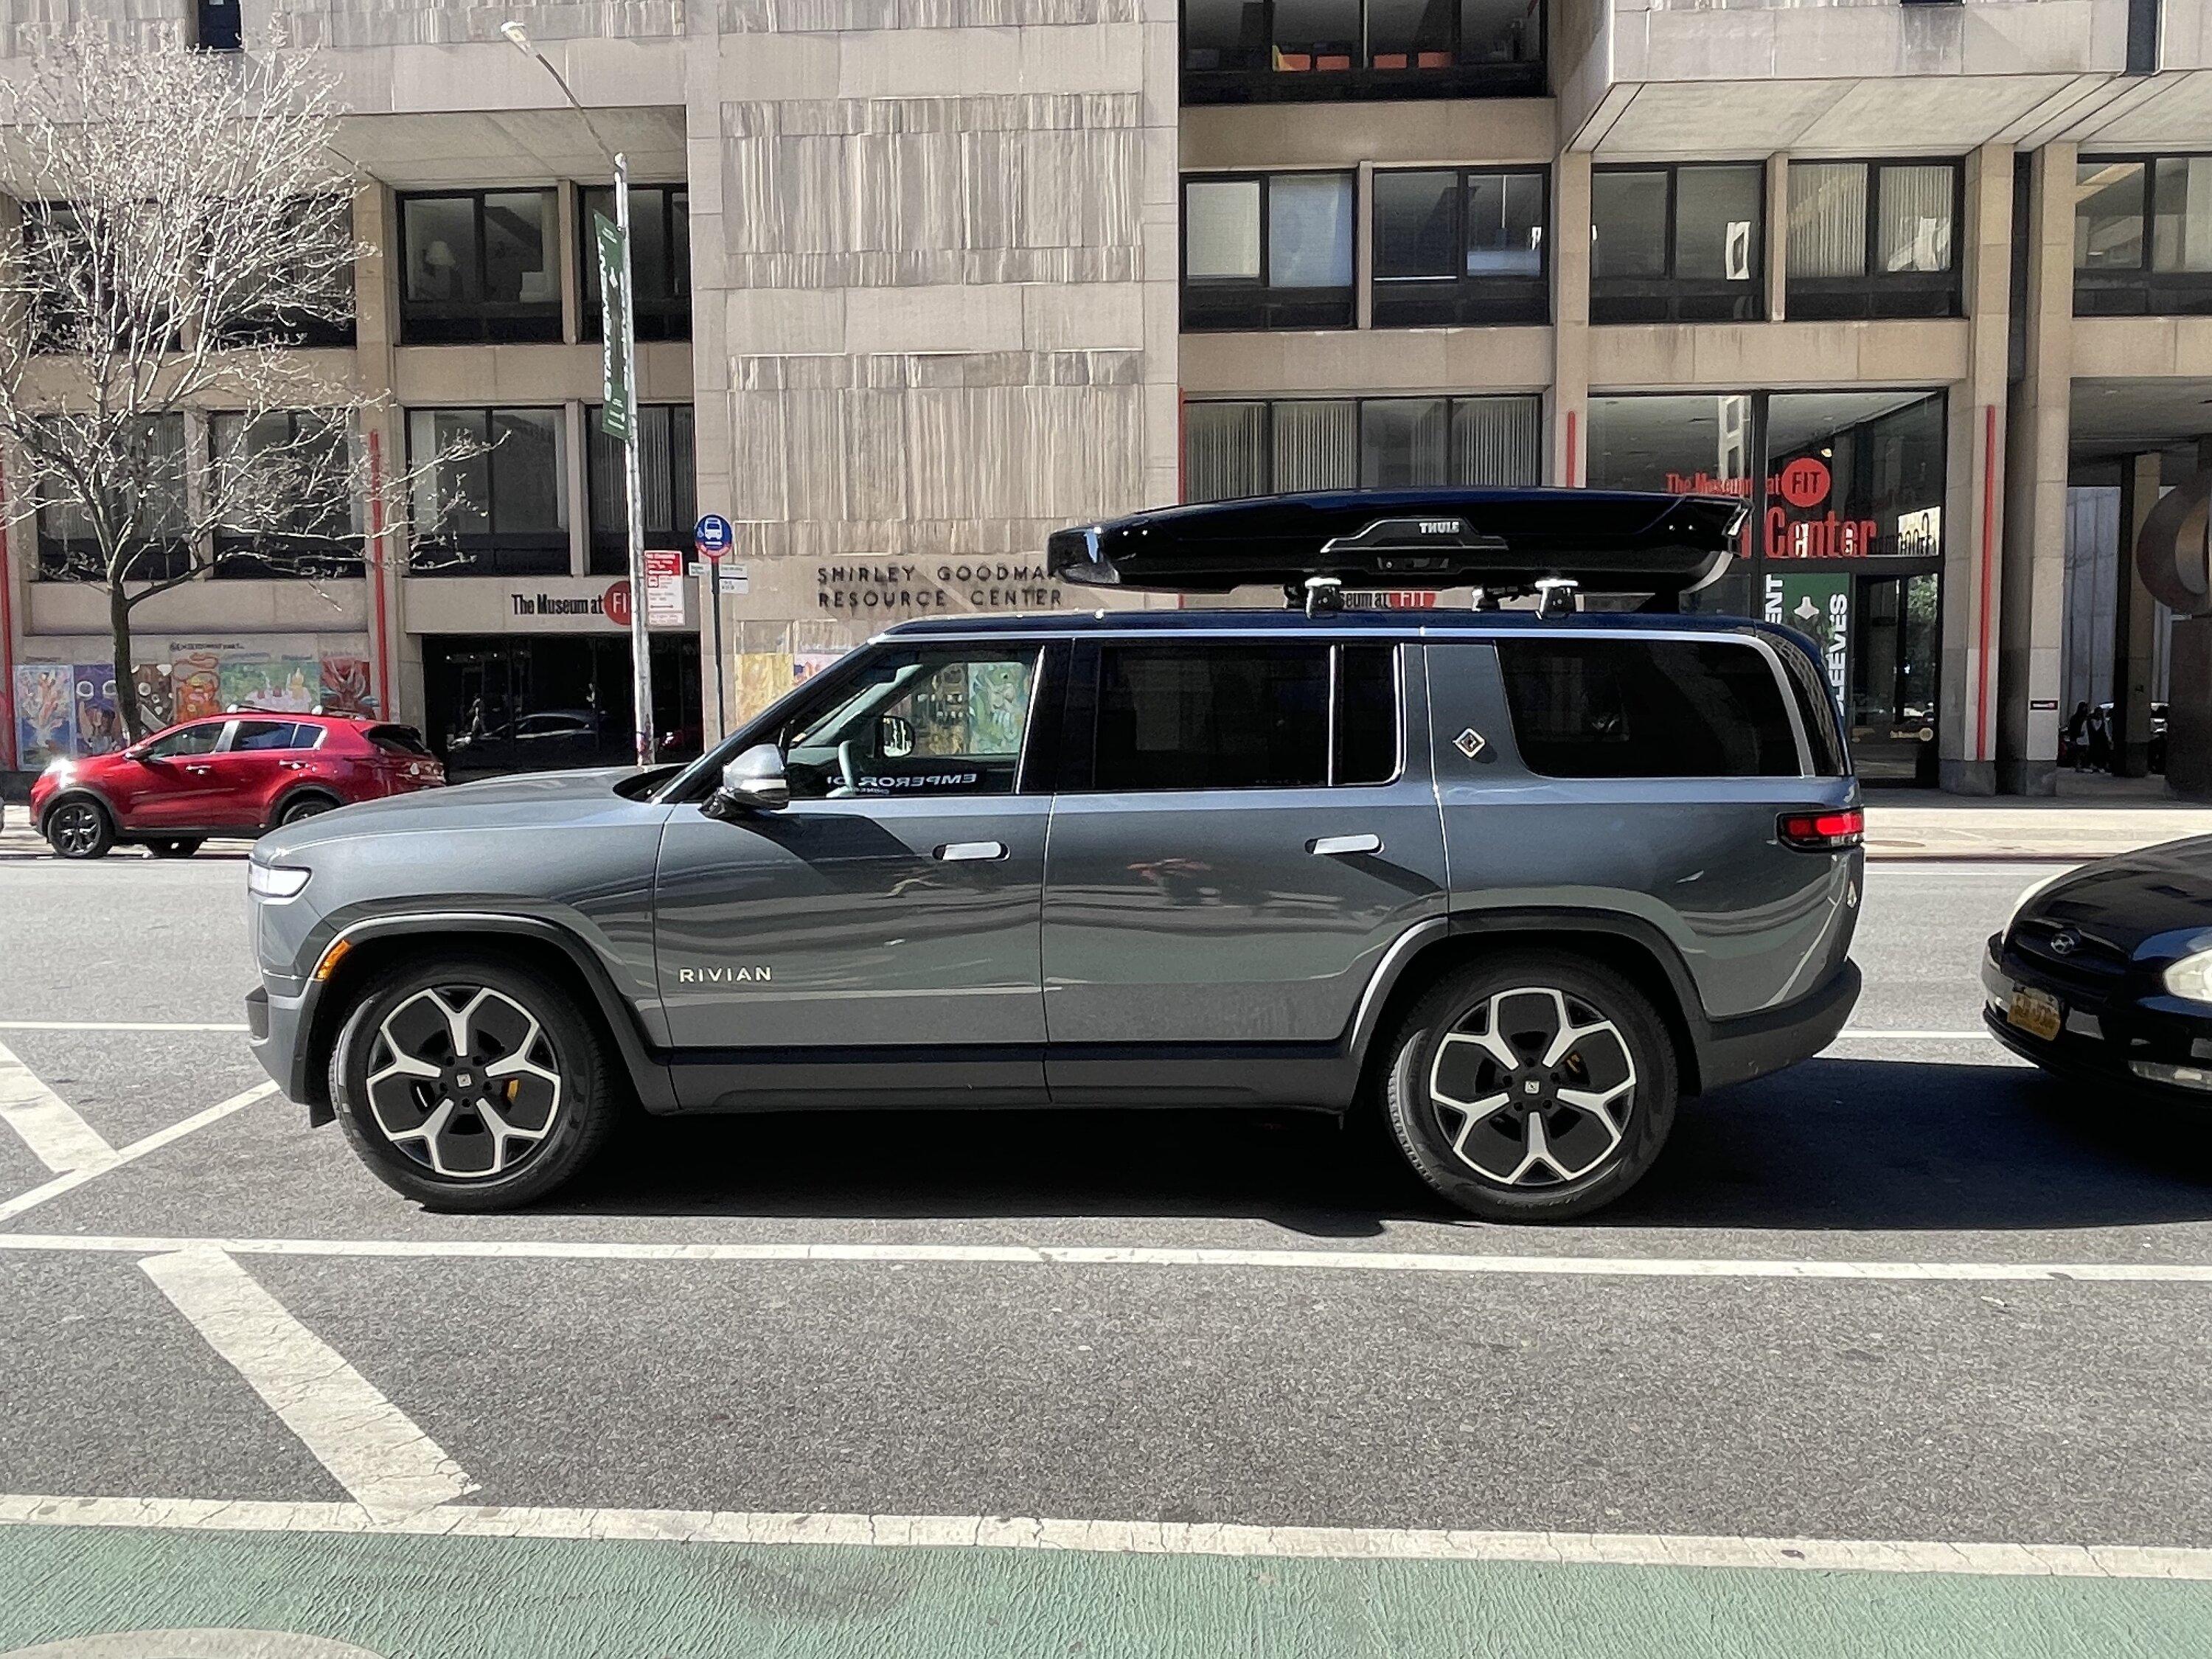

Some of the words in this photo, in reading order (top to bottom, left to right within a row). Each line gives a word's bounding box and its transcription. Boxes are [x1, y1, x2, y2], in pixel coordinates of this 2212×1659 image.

[1666, 473, 1691, 493] The
[1767, 473, 1781, 495] at
[1792, 471, 1821, 495] FIT
[1419, 521, 1459, 534] THULE
[1766, 507, 1877, 558] Center
[817, 566, 915, 582] SHIRLEY
[937, 565, 1056, 581] GOODMA
[511, 594, 535, 615] The
[537, 594, 588, 615] Museum
[591, 594, 604, 614] at
[613, 592, 631, 613] FI
[818, 589, 946, 608] RESOURCE
[970, 588, 1062, 607] CENTER
[1765, 574, 1784, 625] ENT
[679, 967, 772, 983] RIVIAN
